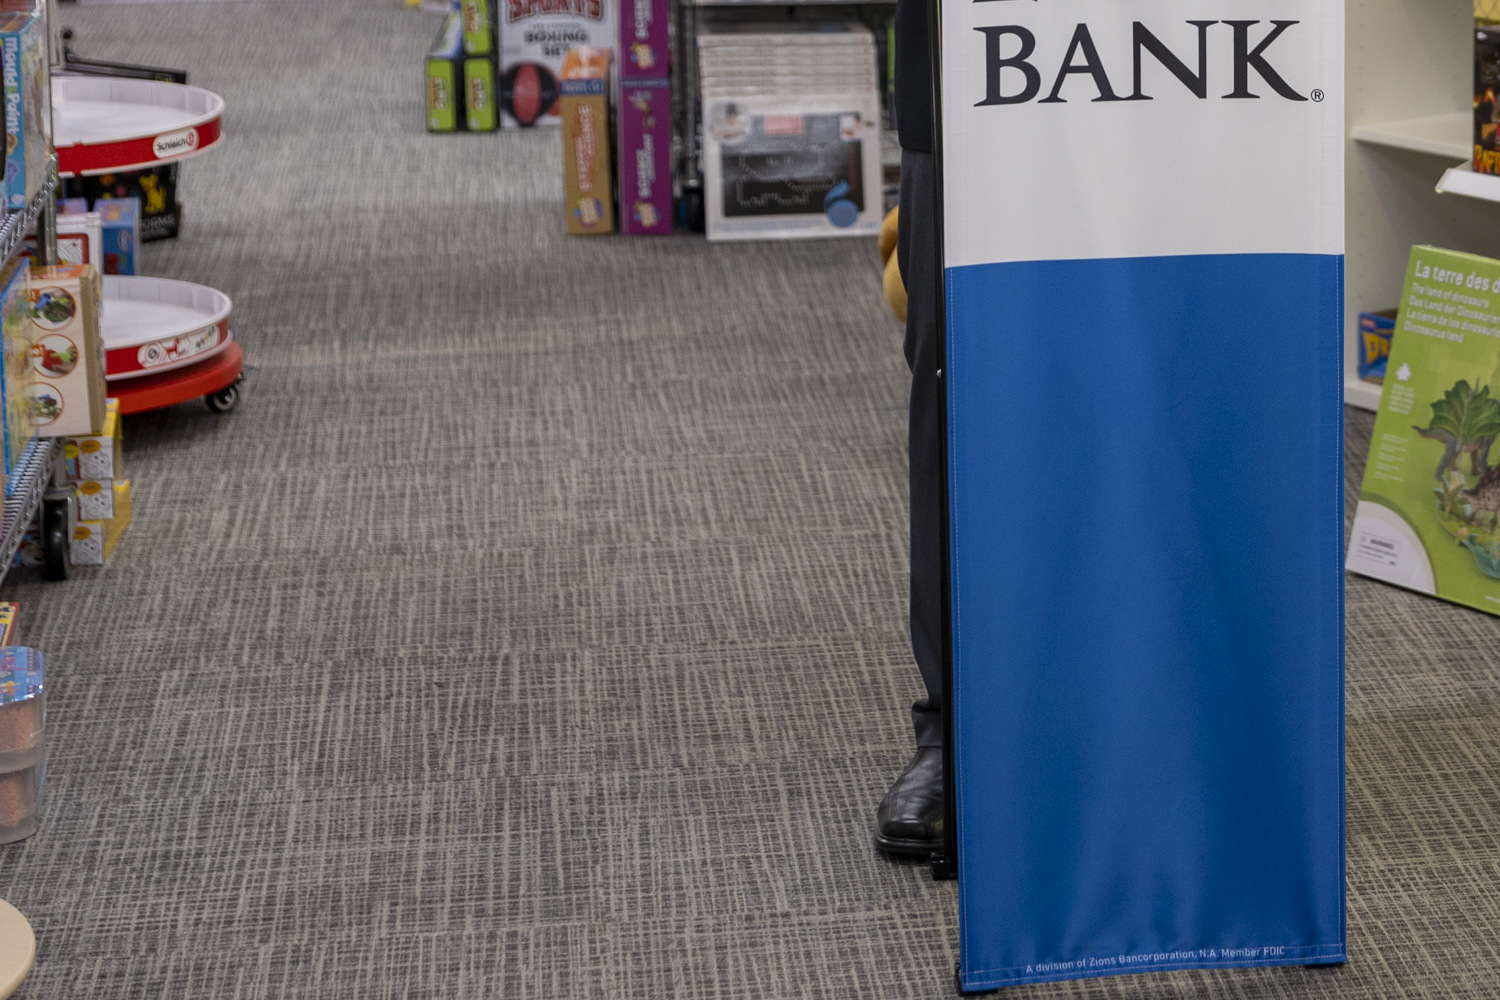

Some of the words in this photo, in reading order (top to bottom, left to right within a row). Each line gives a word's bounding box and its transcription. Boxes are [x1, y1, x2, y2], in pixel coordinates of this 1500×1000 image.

[156, 137, 187, 151] Schleich
[1415, 259, 1431, 280] La
[1432, 264, 1463, 287] terre
[1465, 270, 1490, 292] des
[1411, 282, 1425, 294] The
[1425, 284, 1442, 298] land
[1451, 288, 1490, 308] dinosaurs
[1424, 297, 1441, 311] Land
[1442, 300, 1455, 313] der
[1416, 309, 1434, 323] tierra
[1434, 312, 1445, 325] de
[1026, 964, 1034, 974] A
[1035, 959, 1073, 973] division
[1076, 957, 1087, 969] of
[1089, 955, 1116, 968] Zions
[1119, 948, 1199, 966] Bancorporation,
[1200, 948, 1219, 959] N.A.
[1221, 947, 1261, 958] Member
[1264, 946, 1286, 957] FDIC
